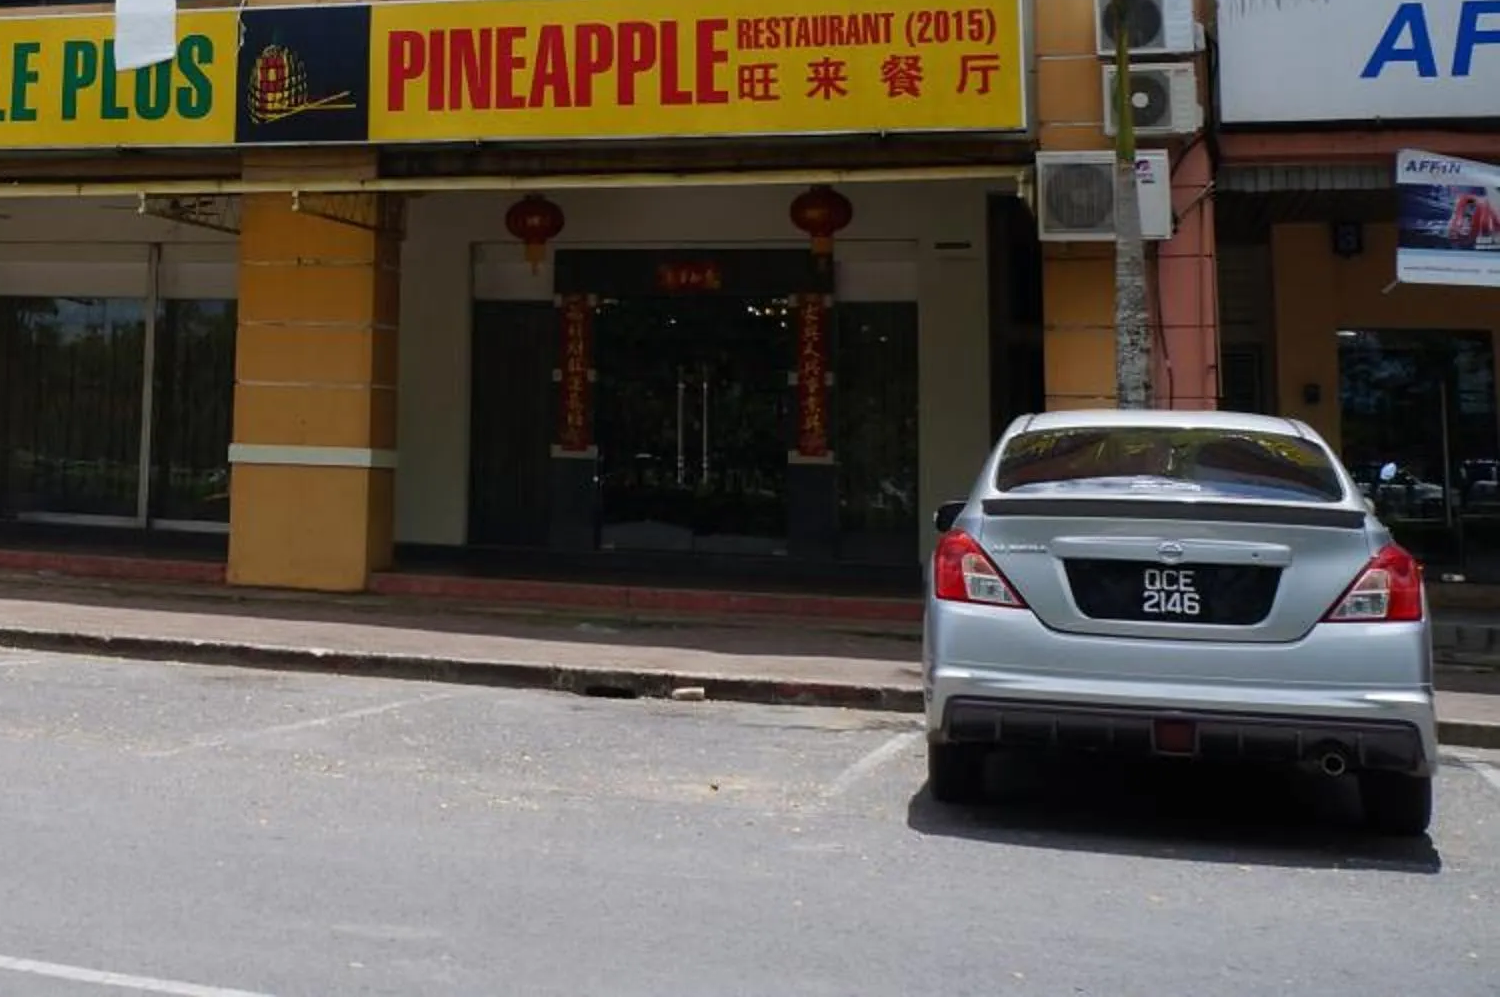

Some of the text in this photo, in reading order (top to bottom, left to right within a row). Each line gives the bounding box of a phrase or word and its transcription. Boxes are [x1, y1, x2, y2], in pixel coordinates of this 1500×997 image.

[736, 8, 997, 51] RESTAURANT (2015)
[387, 18, 729, 111] PINEAPPLE
[737, 53, 1000, 103] 旺来餐厅
[1145, 569, 1196, 592] QCE
[1143, 591, 1200, 615] 2146
